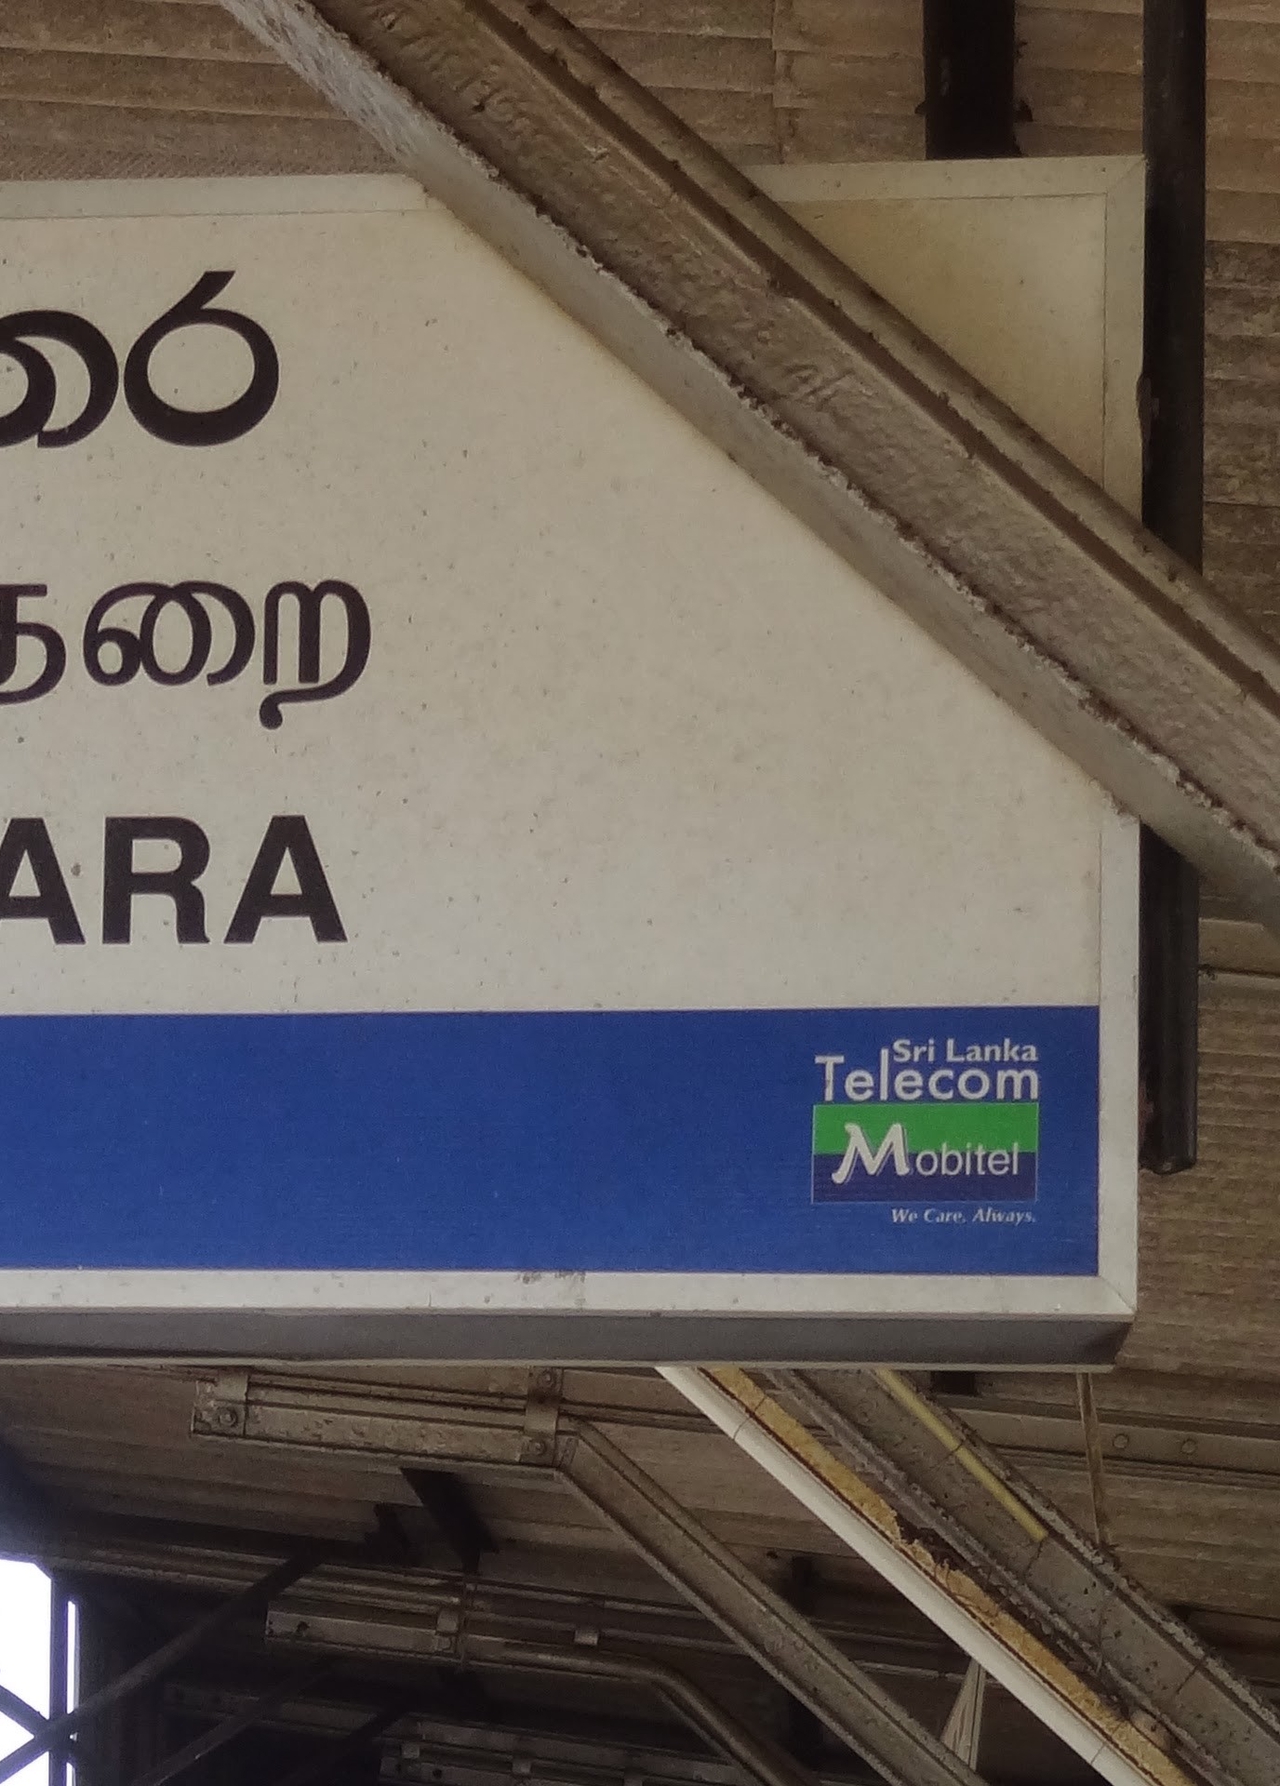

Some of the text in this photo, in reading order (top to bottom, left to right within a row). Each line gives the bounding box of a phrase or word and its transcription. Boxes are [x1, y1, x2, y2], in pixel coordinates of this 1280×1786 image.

[893, 1038, 1038, 1063] Sri Lanka
[815, 1048, 1039, 1102] Telecom
[831, 1122, 1020, 1184] Mobitel
[892, 1208, 918, 1223] We
[972, 1206, 1036, 1226] Always.
